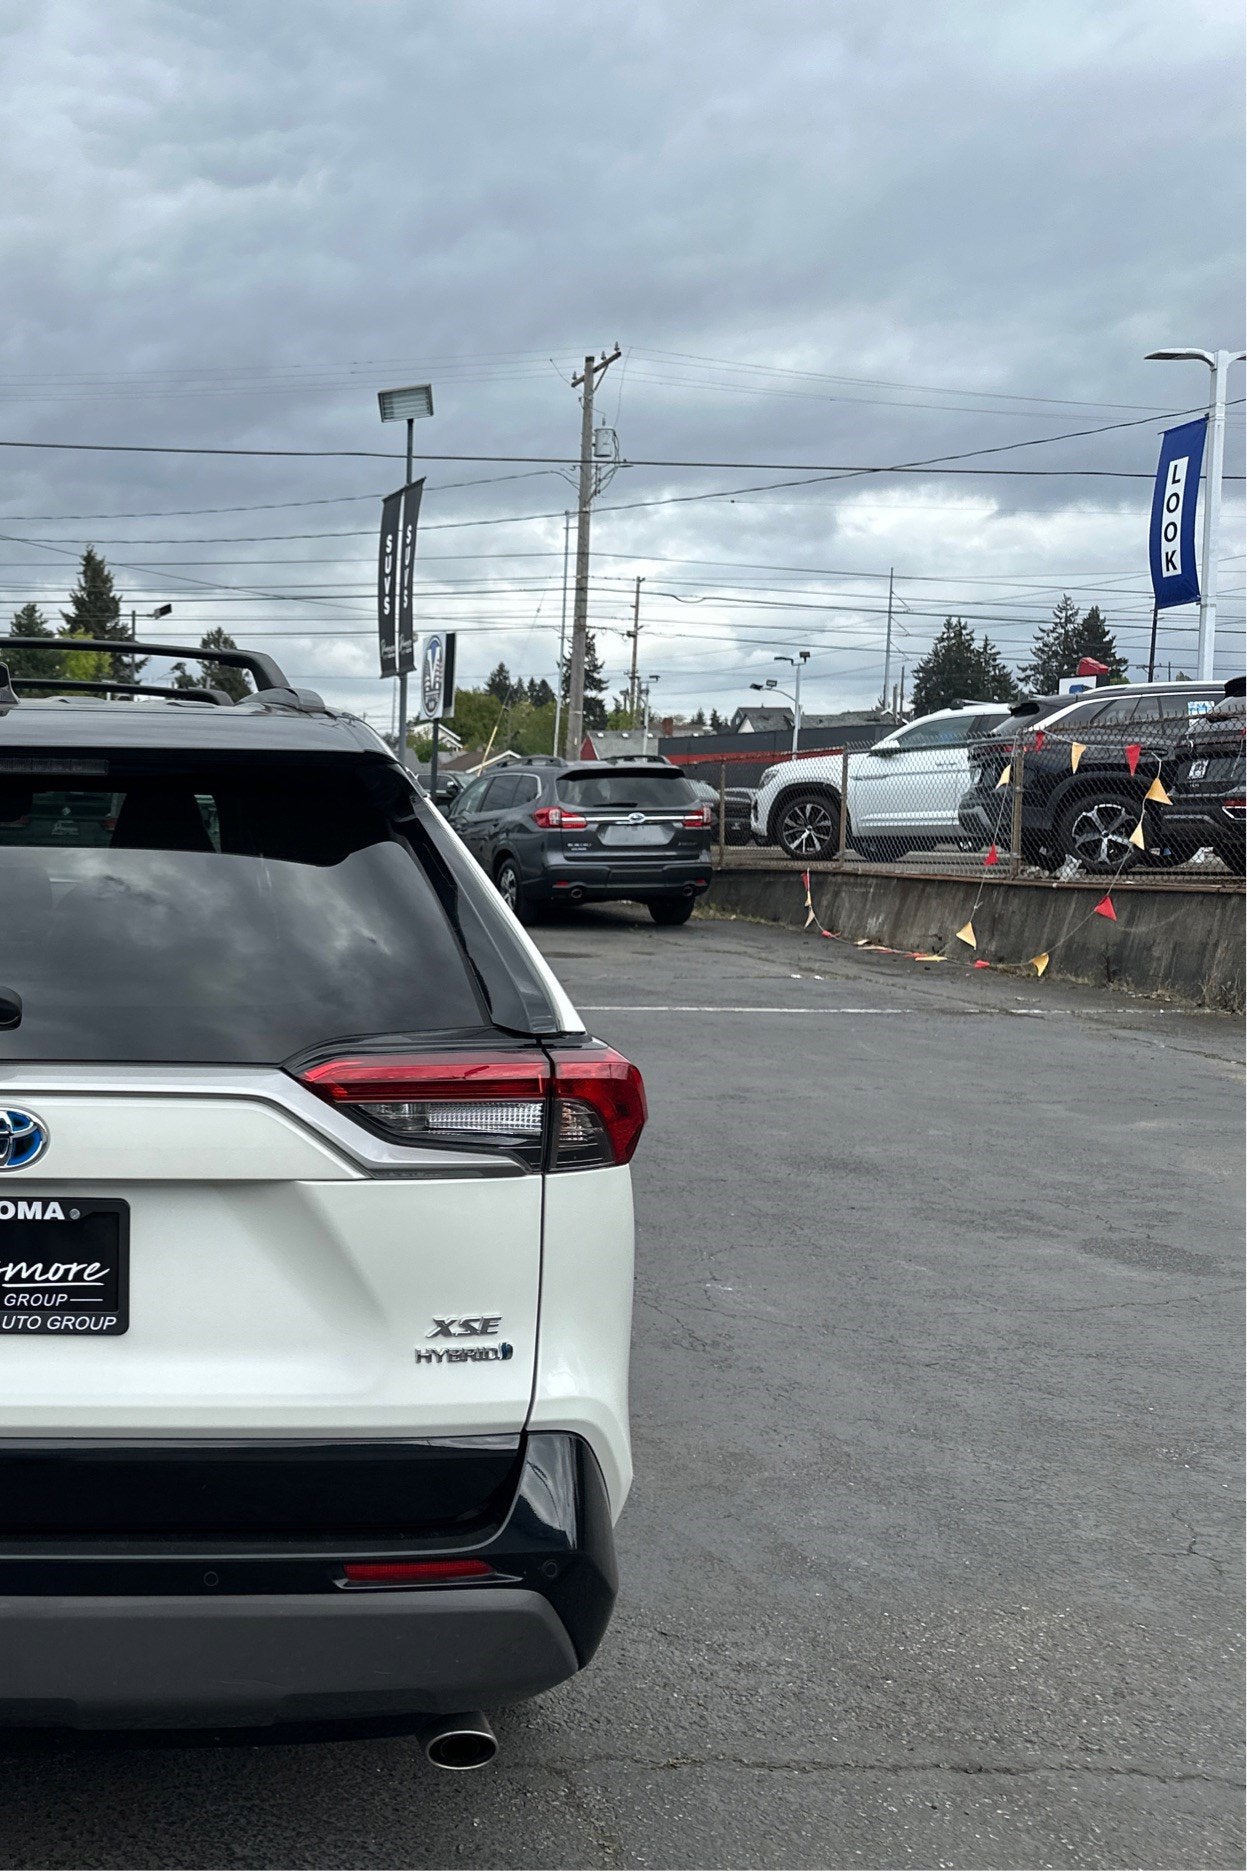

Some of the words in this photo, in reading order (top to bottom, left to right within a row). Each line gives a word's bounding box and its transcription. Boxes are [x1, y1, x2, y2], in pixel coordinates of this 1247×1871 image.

[1163, 464, 1181, 573] LOOK
[383, 534, 393, 616] SUVS
[3, 1293, 68, 1307] GROUP
[46, 1315, 117, 1330] GROUP
[425, 1313, 503, 1338] XSE
[414, 1346, 501, 1364] HYBRID
